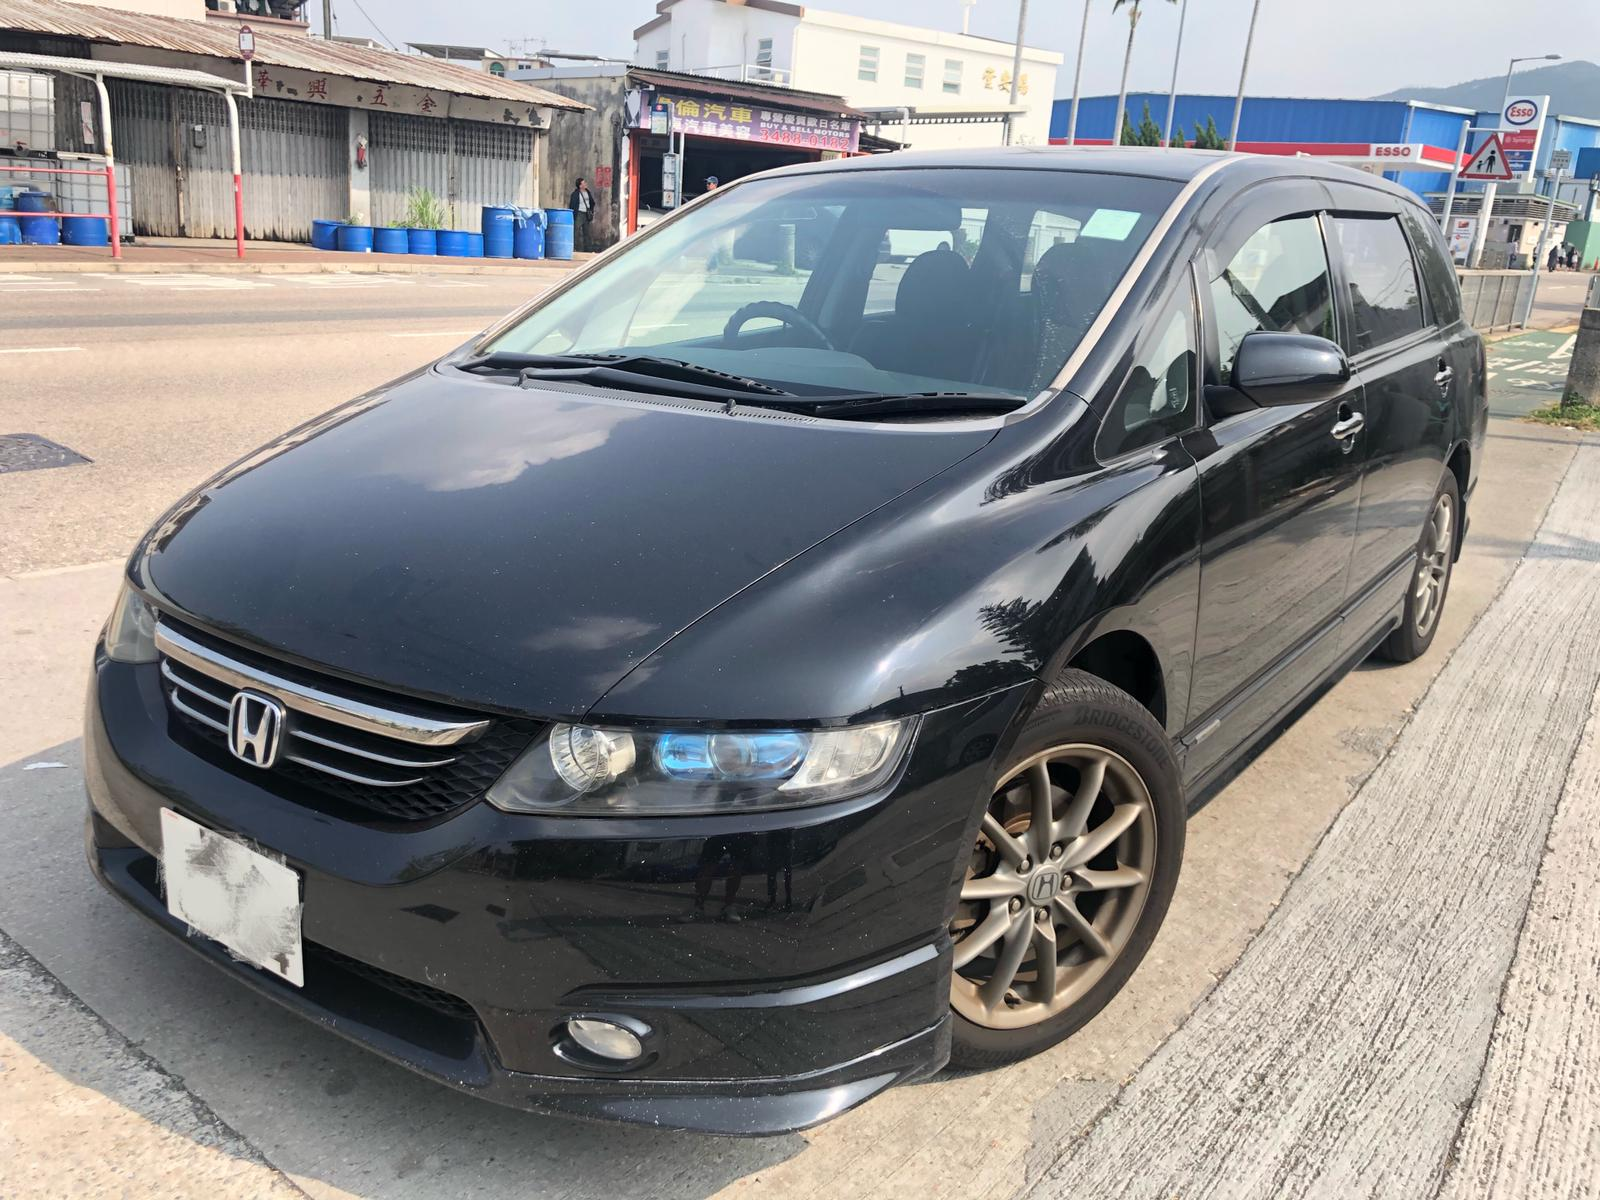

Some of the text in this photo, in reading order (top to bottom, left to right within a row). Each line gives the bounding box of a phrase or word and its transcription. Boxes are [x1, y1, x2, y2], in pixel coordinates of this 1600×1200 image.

[760, 122, 781, 130] BUY
[790, 126, 812, 134] SELL
[814, 129, 850, 138] MOTORS
[760, 128, 850, 150] 3488-0182
[1375, 146, 1411, 157] ESSO
[1073, 705, 1170, 769] BRIDGESTONE
